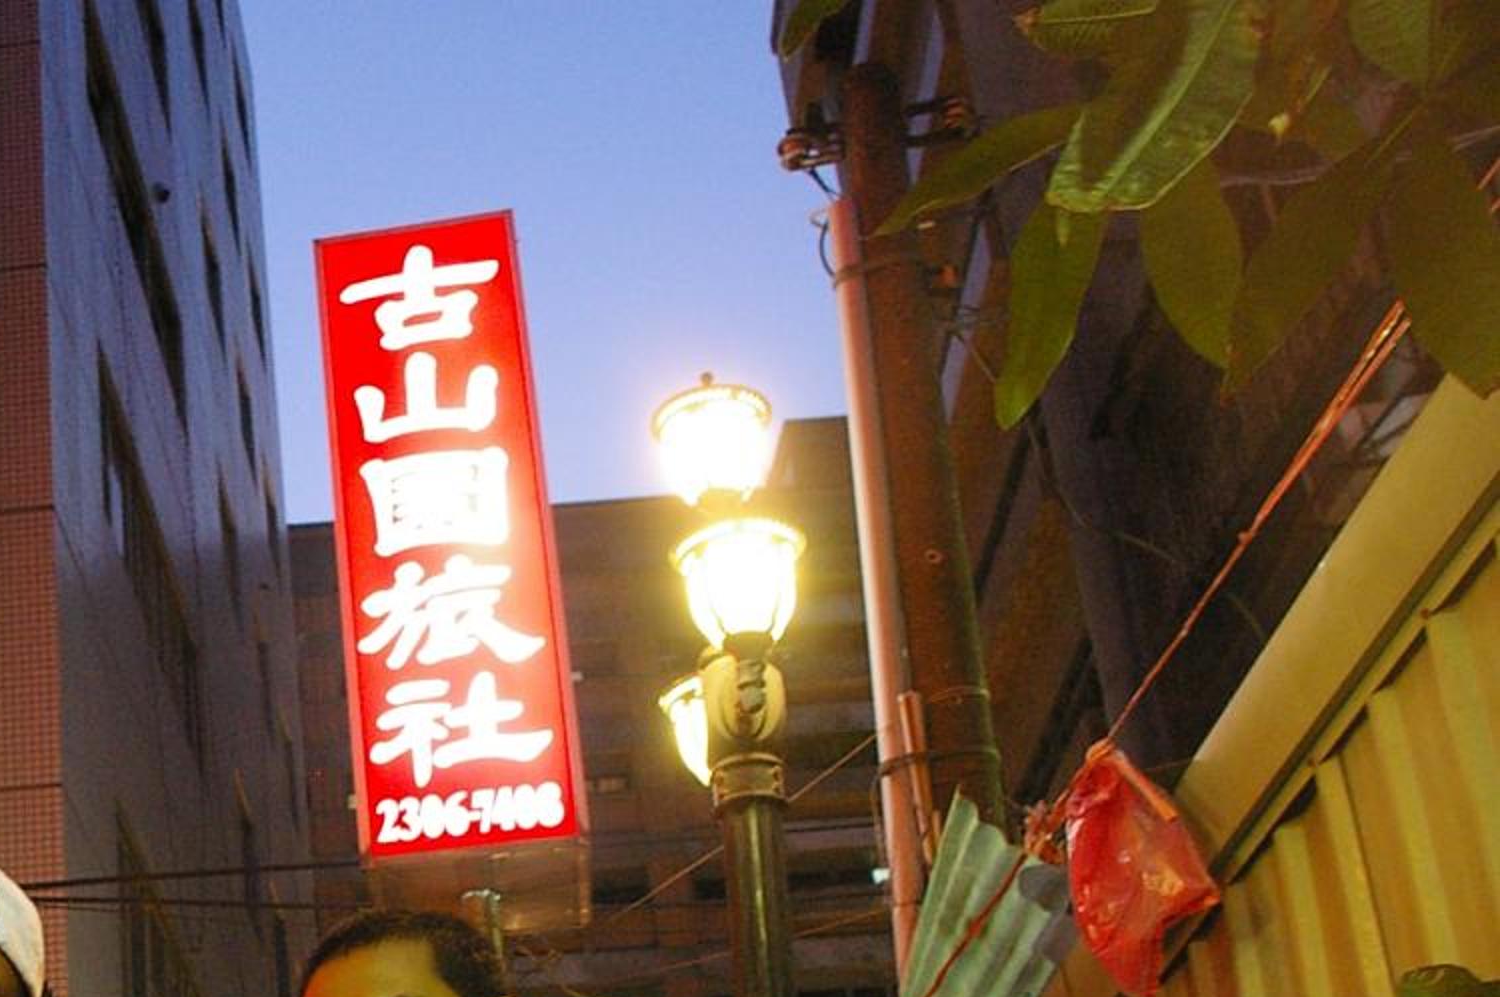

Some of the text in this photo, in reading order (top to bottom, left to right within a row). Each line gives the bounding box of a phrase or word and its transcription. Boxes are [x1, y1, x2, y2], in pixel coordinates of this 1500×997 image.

[340, 245, 554, 788] 古山園旅社
